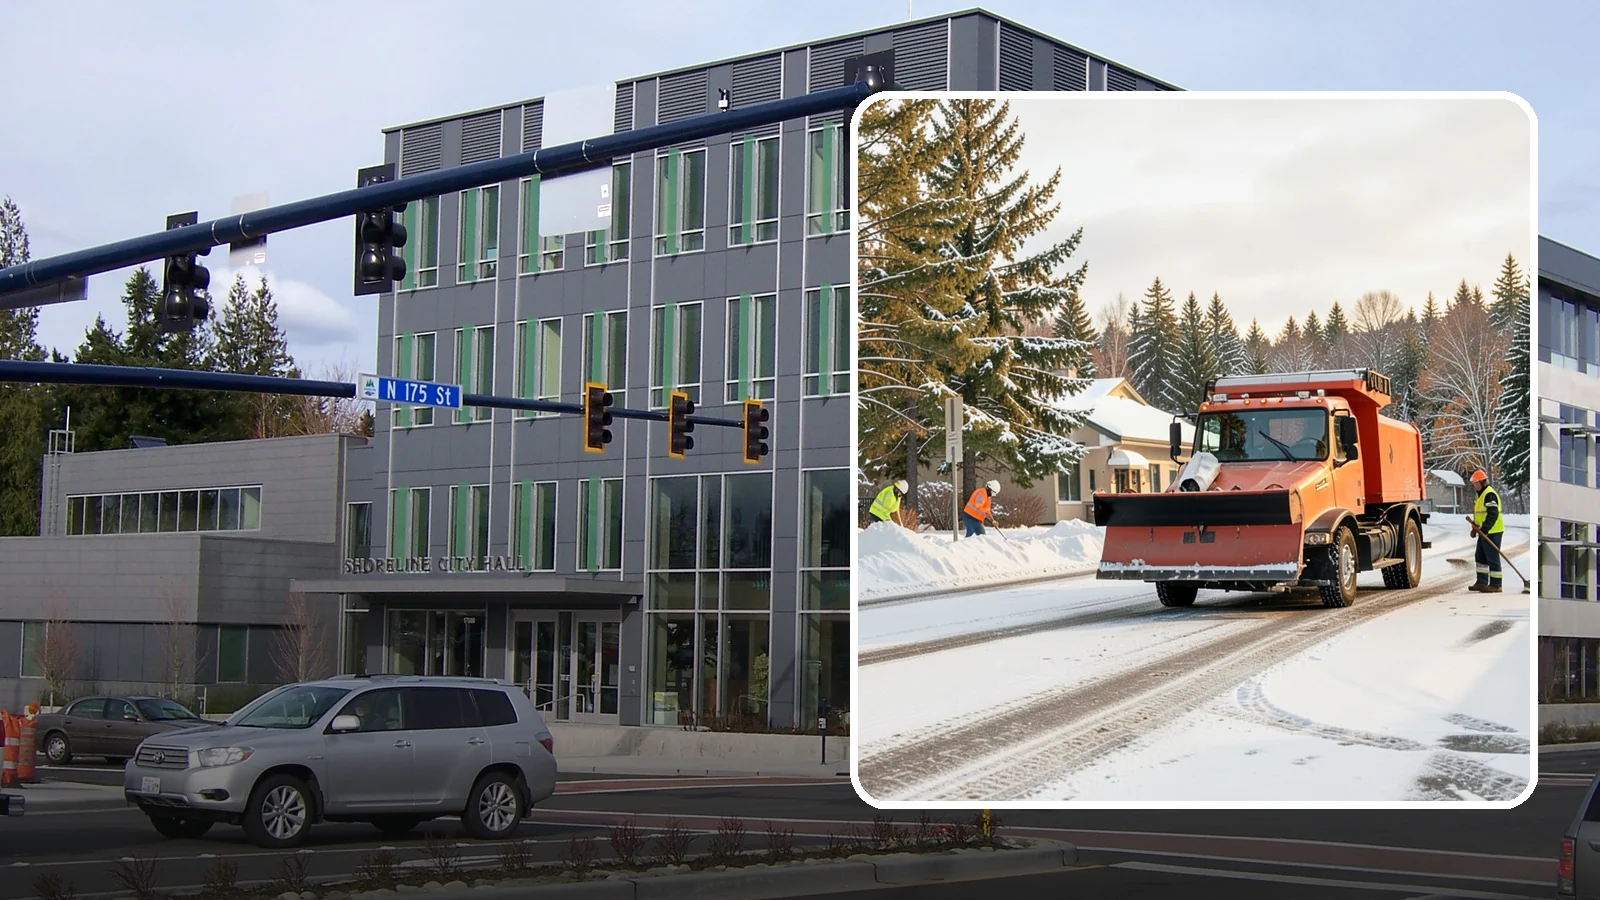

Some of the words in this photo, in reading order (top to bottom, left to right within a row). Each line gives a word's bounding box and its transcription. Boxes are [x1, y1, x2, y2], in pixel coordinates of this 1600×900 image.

[387, 380, 396, 399] N
[405, 382, 427, 403] 175
[436, 386, 451, 406] St
[344, 556, 432, 574] SHORELINE
[438, 556, 475, 573] CITY
[483, 555, 526, 572] HALL
